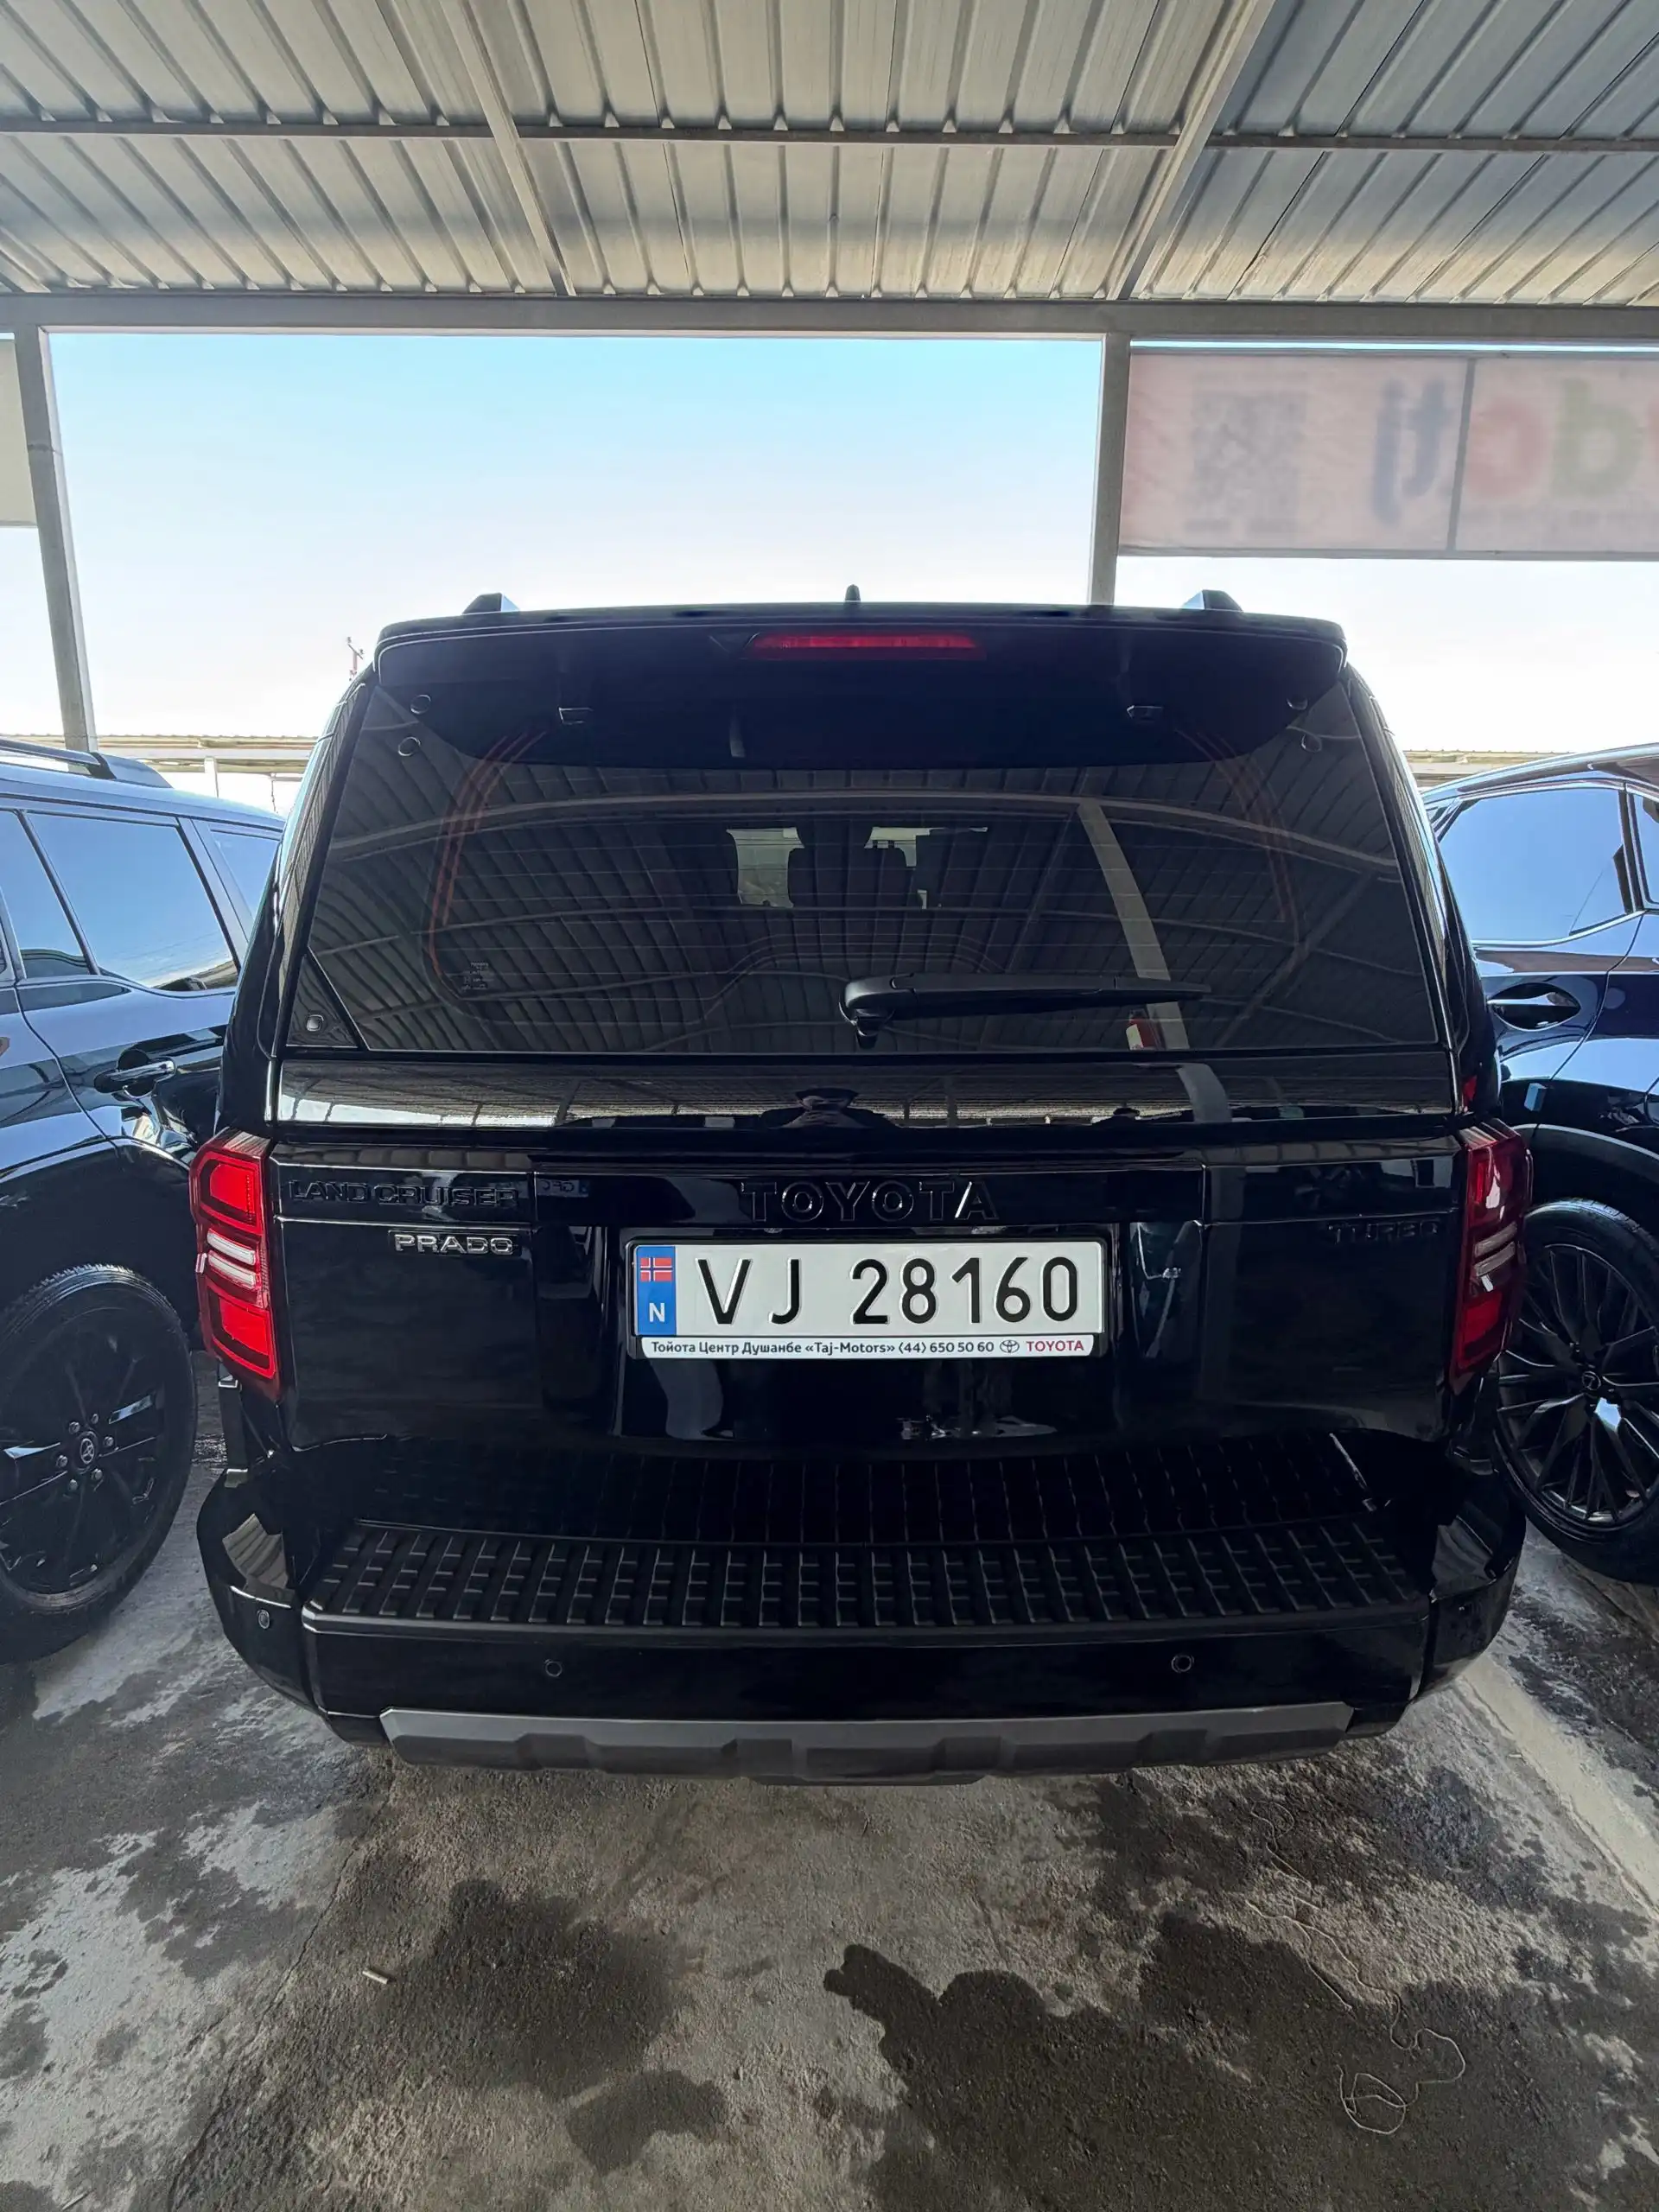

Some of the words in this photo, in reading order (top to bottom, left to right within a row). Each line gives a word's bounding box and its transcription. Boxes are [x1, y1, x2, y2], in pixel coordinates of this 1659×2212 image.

[289, 1180, 368, 1204] LAND
[374, 1184, 518, 1208] CRUISER
[741, 1180, 999, 1221] TOYOTA
[394, 1234, 514, 1255] PRADO
[852, 1256, 1077, 1325] 28160
[649, 1302, 665, 1323] N
[652, 1341, 696, 1354] Тойота
[699, 1341, 738, 1357] Центр
[741, 1341, 802, 1356] Душанбе
[805, 1341, 895, 1355] «Taj-Motors»
[899, 1342, 926, 1354] (44)
[930, 1342, 954, 1353] 650
[957, 1342, 974, 1353] 50
[977, 1342, 994, 1353] 60
[1026, 1340, 1084, 1352] TOYOTA
